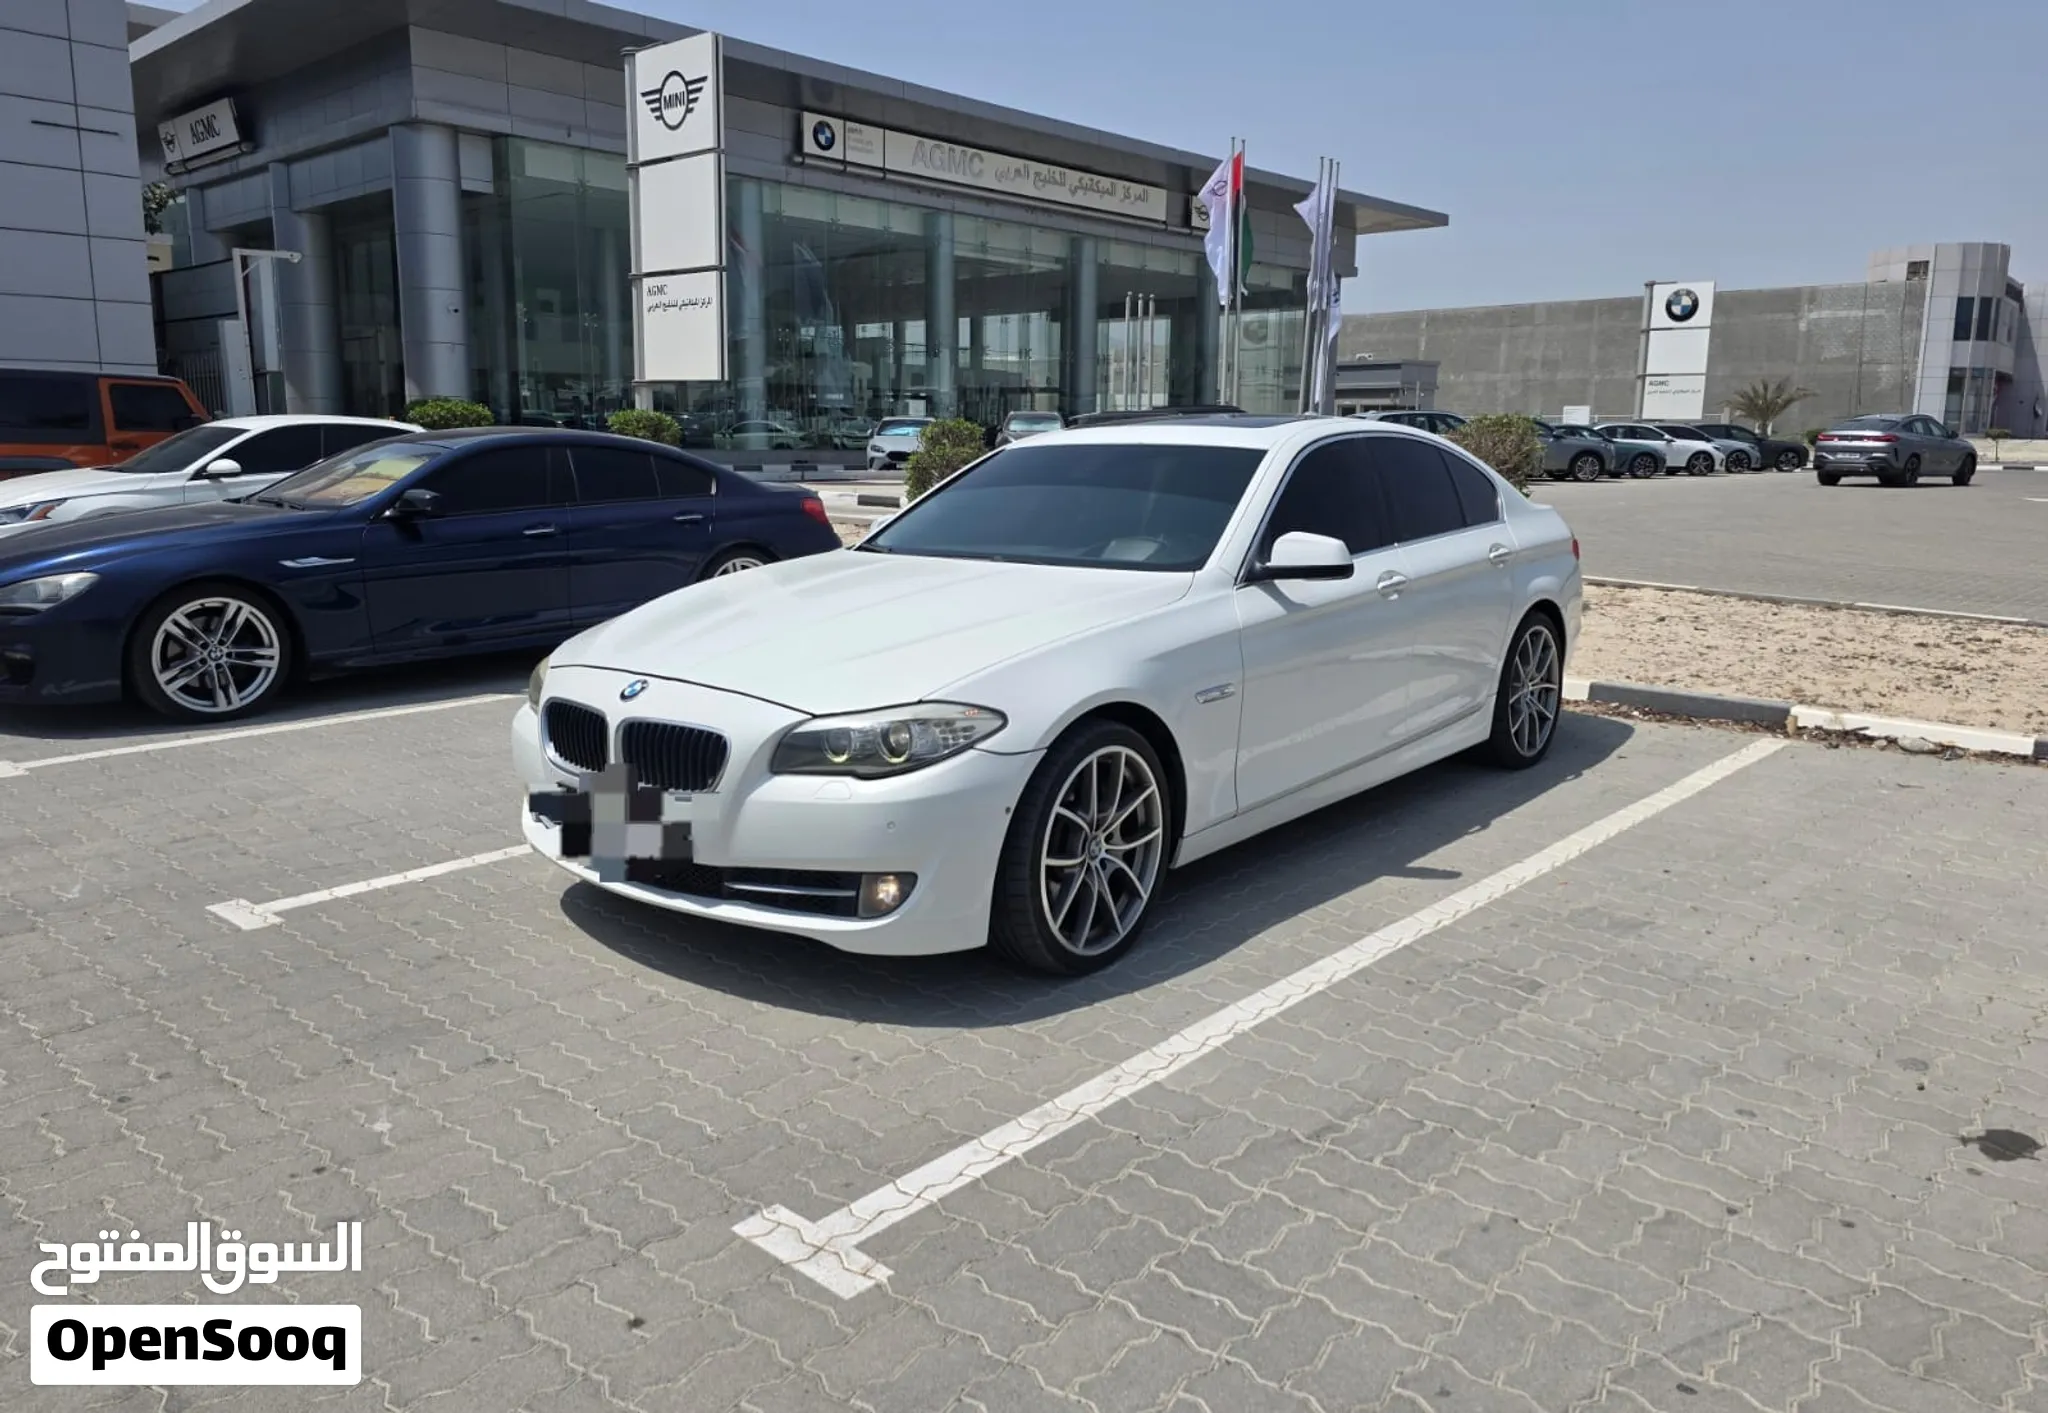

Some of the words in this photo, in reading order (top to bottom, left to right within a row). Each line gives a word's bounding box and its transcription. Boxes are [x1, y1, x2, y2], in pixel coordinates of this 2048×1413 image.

[663, 91, 685, 110] MINI
[189, 113, 220, 145] AGMC
[911, 139, 985, 178] AGMC
[647, 284, 668, 296] AGMC
